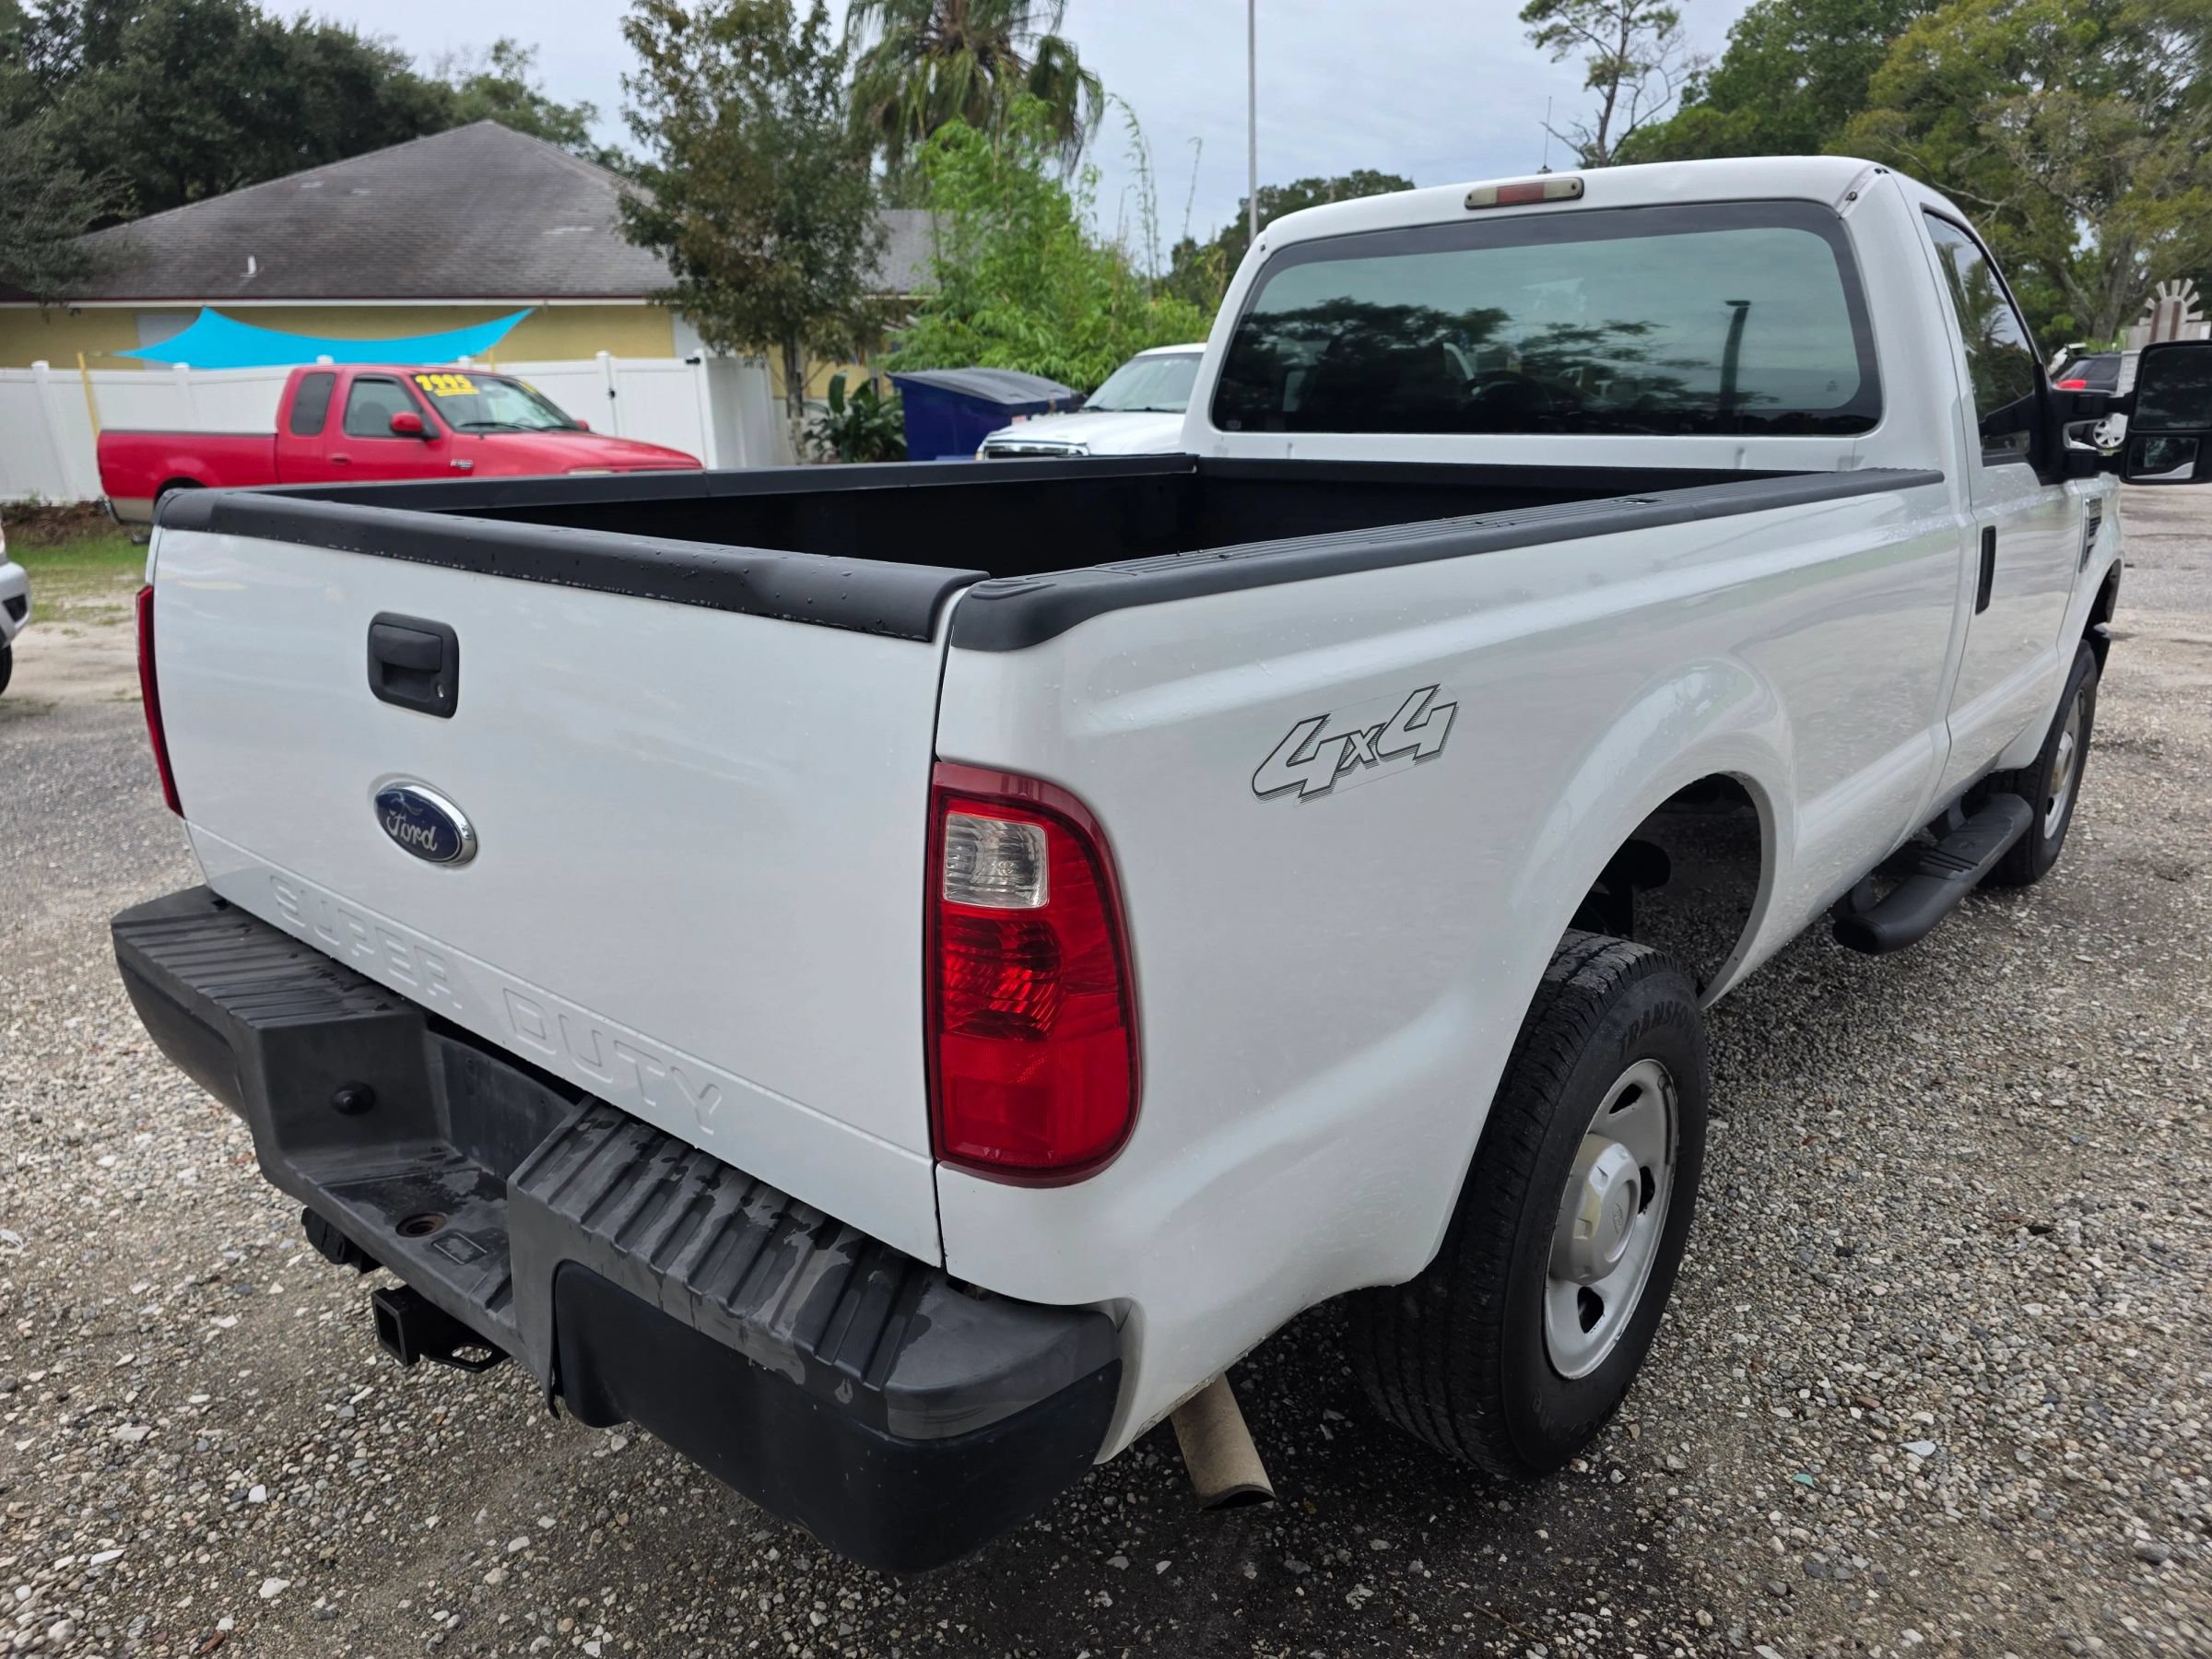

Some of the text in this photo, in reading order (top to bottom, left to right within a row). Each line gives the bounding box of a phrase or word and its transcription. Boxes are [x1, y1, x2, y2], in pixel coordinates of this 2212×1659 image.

[1252, 683, 1459, 804] 4x4
[386, 794, 439, 852] Ford
[269, 874, 723, 1135] SUPER DUTY
